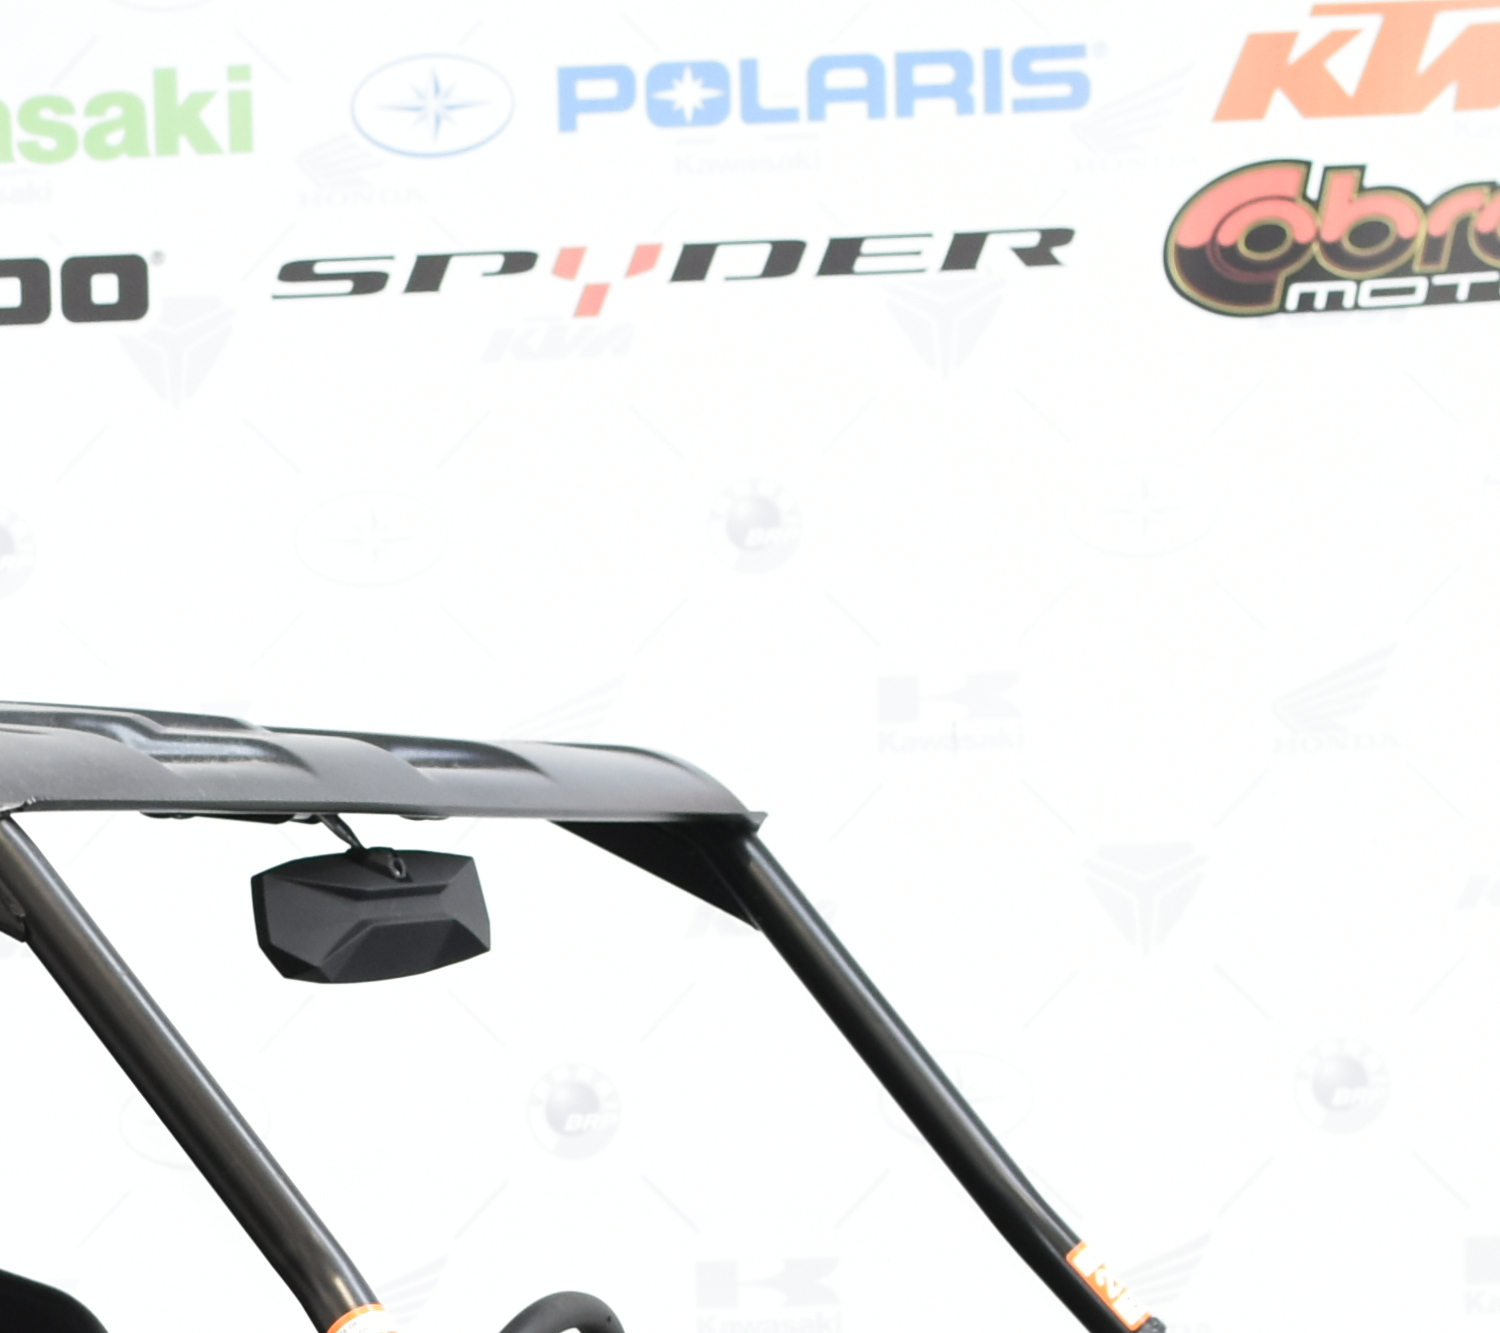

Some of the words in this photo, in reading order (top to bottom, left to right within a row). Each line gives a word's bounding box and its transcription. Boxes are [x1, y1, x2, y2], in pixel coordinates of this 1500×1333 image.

[556, 43, 1092, 134] POLARIS
[271, 226, 1077, 319] SPYDER
[482, 315, 636, 363] KTM
